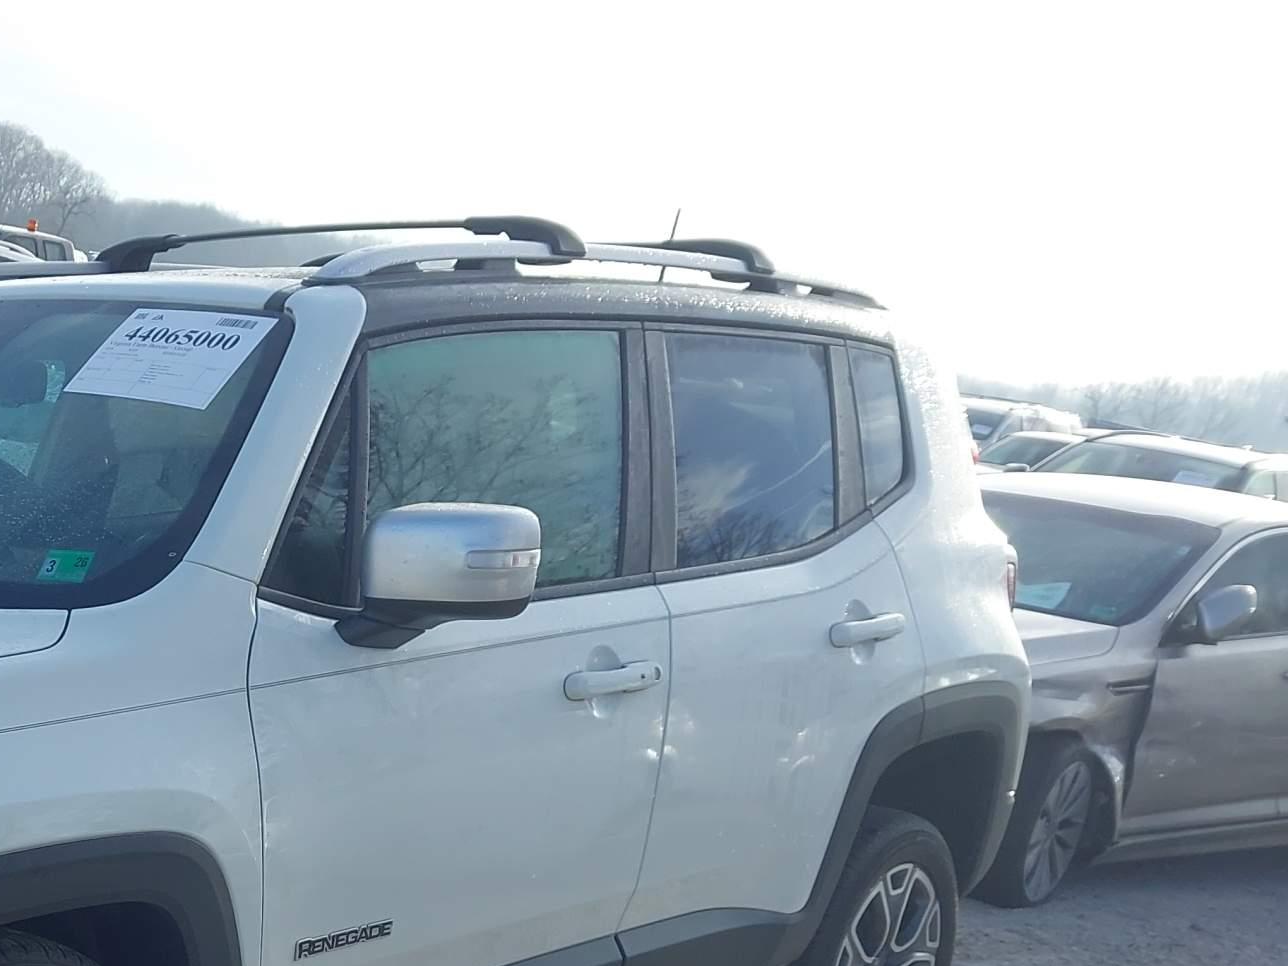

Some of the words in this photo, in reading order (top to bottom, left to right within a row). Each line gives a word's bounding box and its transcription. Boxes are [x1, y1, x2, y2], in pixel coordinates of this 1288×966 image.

[124, 325, 241, 351] 44065000
[45, 559, 57, 573] 3
[293, 918, 394, 961] RENEGADE
